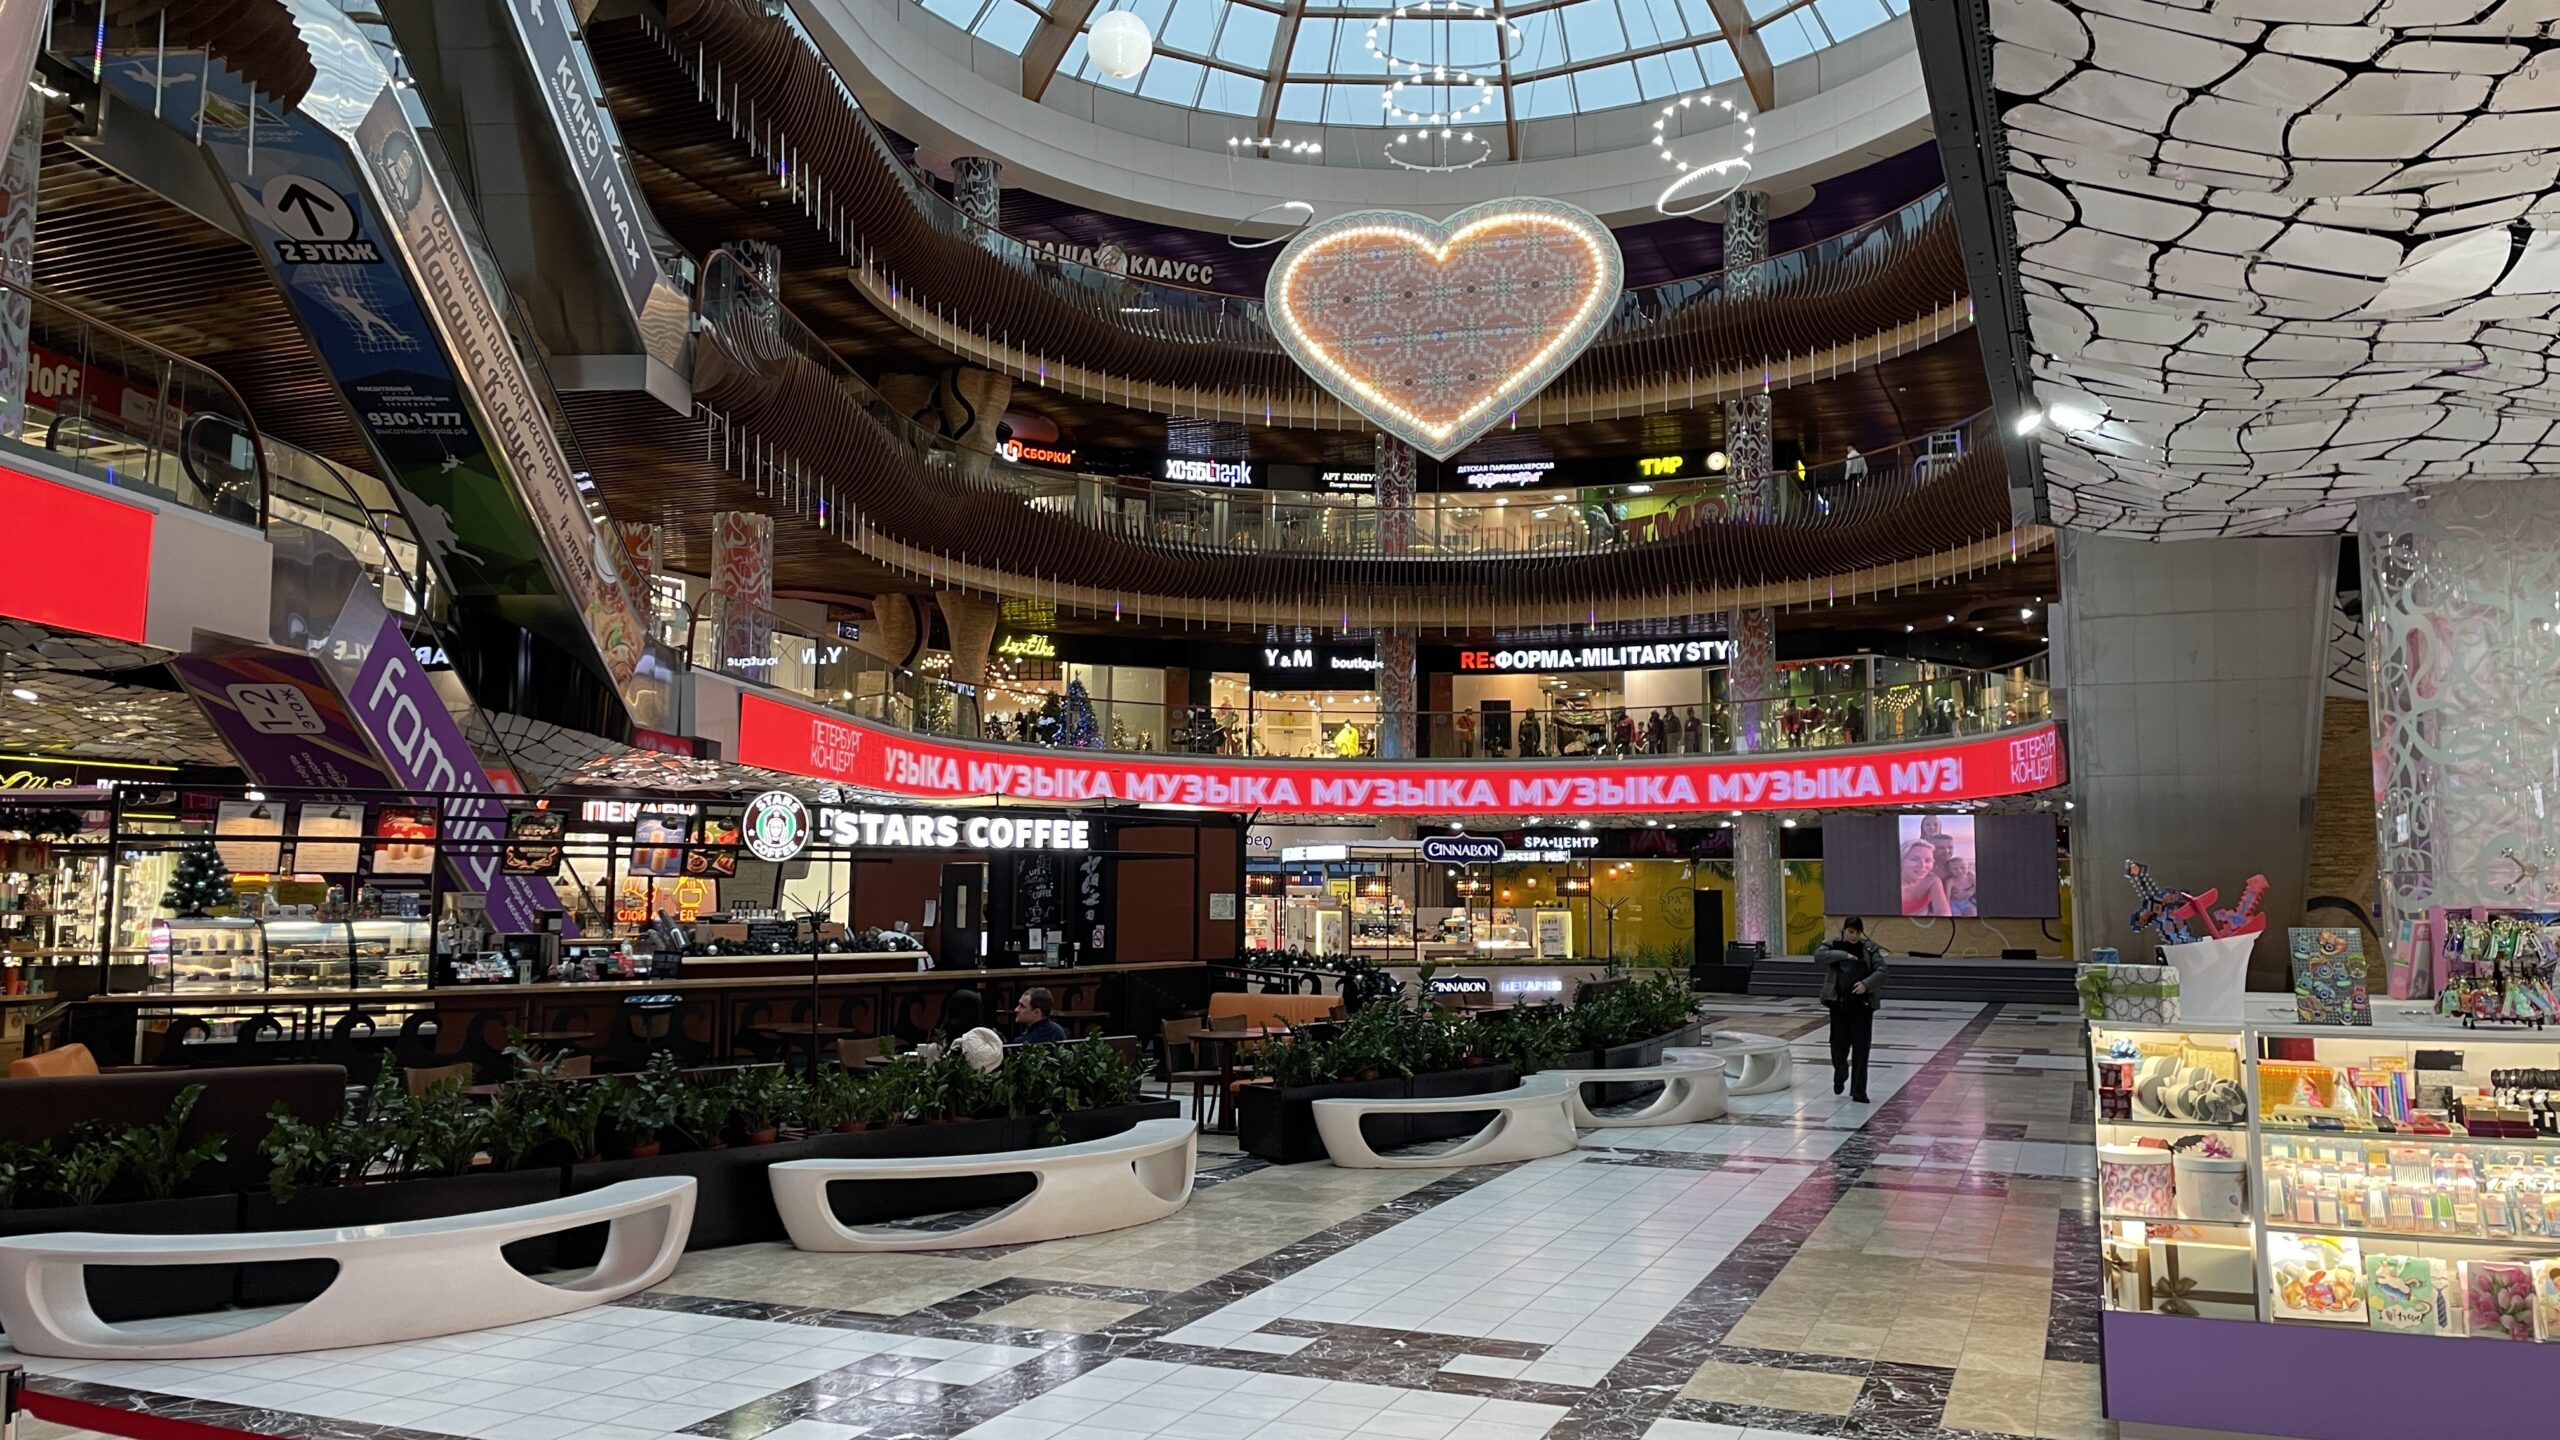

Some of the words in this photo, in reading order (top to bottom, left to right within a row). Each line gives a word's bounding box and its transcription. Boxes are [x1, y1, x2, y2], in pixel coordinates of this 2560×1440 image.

[603, 176, 640, 271] IMAX
[280, 243, 301, 260] 2
[301, 243, 379, 260] ЭТАЖ
[1129, 255, 1214, 285] КЛАУСС
[415, 225, 486, 375] Папаша
[484, 367, 537, 481] Клаусс
[432, 204, 493, 333] Огромный
[487, 332, 529, 410] пивной
[520, 408, 570, 505] ресторан
[1023, 449, 1072, 465] СБОРКИ
[1457, 465, 1489, 474] ДЕТСКАЯ
[1640, 456, 1684, 476] ТИР
[1322, 472, 1341, 481] АРТ
[1343, 472, 1377, 482] КОНТУ
[558, 513, 570, 531] 4
[278, 687, 316, 730] этаж
[811, 719, 863, 752] ПЕТЕРБУРГ
[810, 749, 856, 776] КОНЦЕРТ
[2010, 756, 2054, 784] КОНЦЕРТ
[967, 760, 1118, 798] МУЗЫКА
[1125, 772, 1302, 805] МУЗЫКА
[1310, 778, 1501, 807] МУЗЫКА
[1509, 775, 1696, 807] МУЗЫКА
[1708, 768, 1883, 803] МУЗЫКА
[755, 794, 801, 814] STARS
[832, 813, 958, 848] STARS
[965, 816, 1090, 850] COFFEE
[752, 839, 799, 859] COFFEE
[1427, 842, 1499, 857] CINNABON
